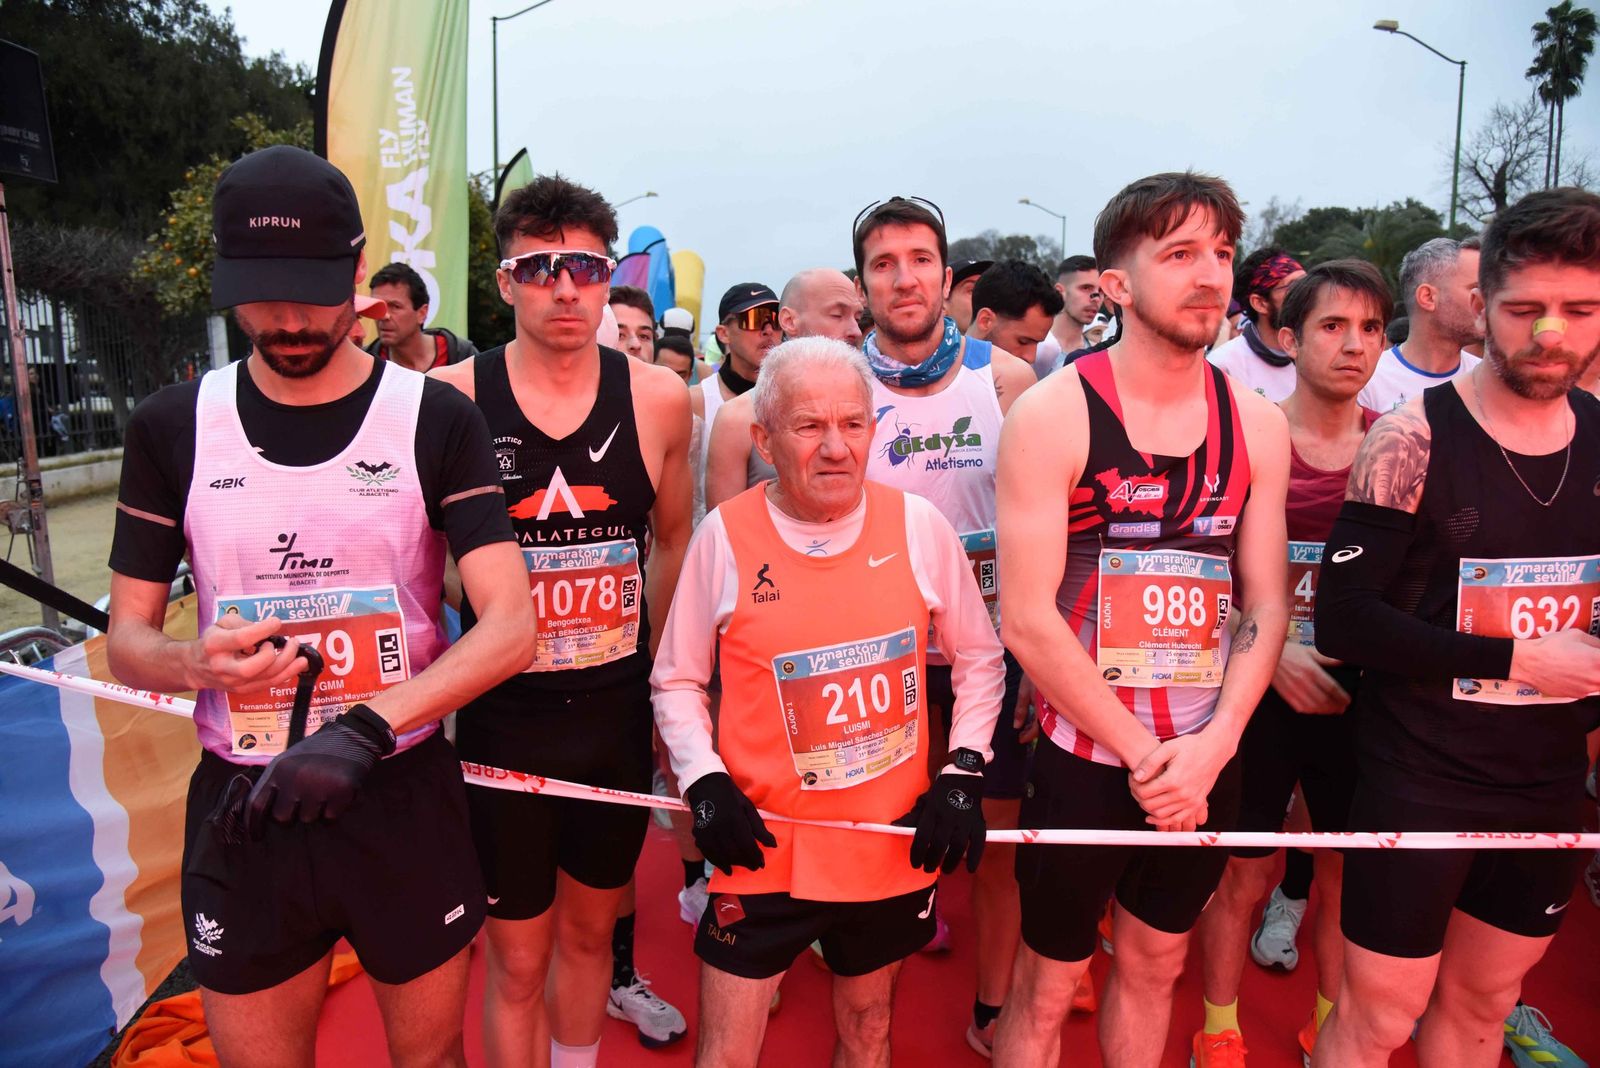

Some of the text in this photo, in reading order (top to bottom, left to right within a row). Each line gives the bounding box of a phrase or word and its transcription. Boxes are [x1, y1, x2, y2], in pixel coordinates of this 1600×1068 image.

[379, 128, 402, 169] FLY
[249, 216, 301, 228] KIPRUN
[925, 456, 984, 472] Atletismo
[209, 476, 246, 489] 42K
[545, 548, 600, 560] maratón
[1152, 554, 1195, 566] maratón
[560, 556, 599, 568] sevilla
[1164, 562, 1196, 575] sevilla
[1523, 561, 1576, 574] maratón
[256, 573, 283, 581] INSTITUTO
[283, 571, 315, 580] MUNICIPAL
[323, 569, 350, 578] DEPORTES
[1534, 571, 1576, 583] sevilla
[289, 578, 317, 587] ALBACETE
[272, 593, 338, 610] maratón
[531, 574, 617, 618] 1078
[751, 589, 780, 604] Talai
[289, 602, 339, 620] sevilla
[1142, 584, 1206, 627] 988
[547, 617, 592, 628] Bengoetxea
[1510, 594, 1581, 640] 632
[1152, 627, 1190, 637] CLÉMENT
[823, 642, 878, 661] maratón
[1171, 642, 1202, 650] Hubrecht
[838, 650, 878, 668] sevilla
[319, 679, 345, 691] GMM
[821, 673, 891, 725] 210
[239, 702, 273, 711] Fernando
[313, 707, 334, 716] enero
[843, 720, 871, 735] LUISMI
[810, 744, 828, 752] Luis
[828, 739, 854, 750] Miguel
[854, 731, 883, 744] Sánchez
[845, 767, 865, 778] HOKA
[708, 922, 737, 946] TALAI
